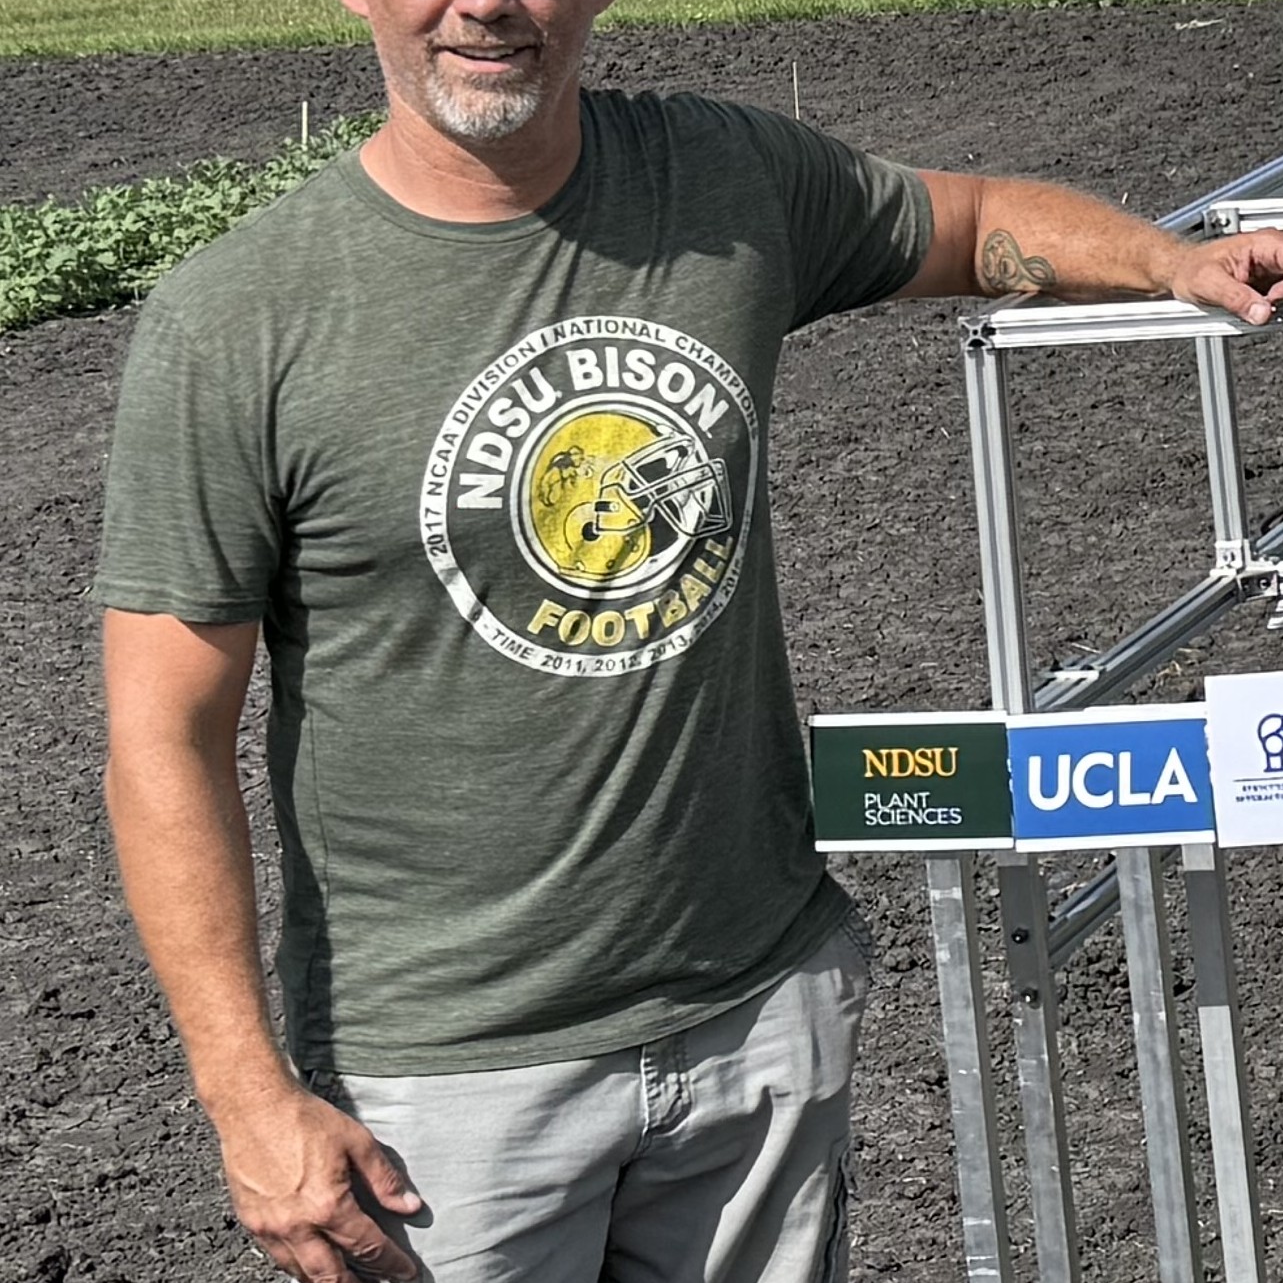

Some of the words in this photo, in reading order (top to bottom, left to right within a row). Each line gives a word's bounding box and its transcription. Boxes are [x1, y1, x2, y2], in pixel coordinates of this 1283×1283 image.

[552, 318, 667, 344] NATIONAL
[453, 341, 537, 425] DIVISION
[456, 366, 557, 509] NDSU
[565, 345, 730, 433] BISON
[426, 433, 460, 496] NCAA
[424, 507, 449, 557] 2017
[526, 535, 733, 647] FOOTBALL
[862, 746, 959, 778] NDSU
[1027, 746, 1198, 811] UCLA
[864, 791, 931, 809] PLANT
[864, 807, 962, 826] SCIENCES
